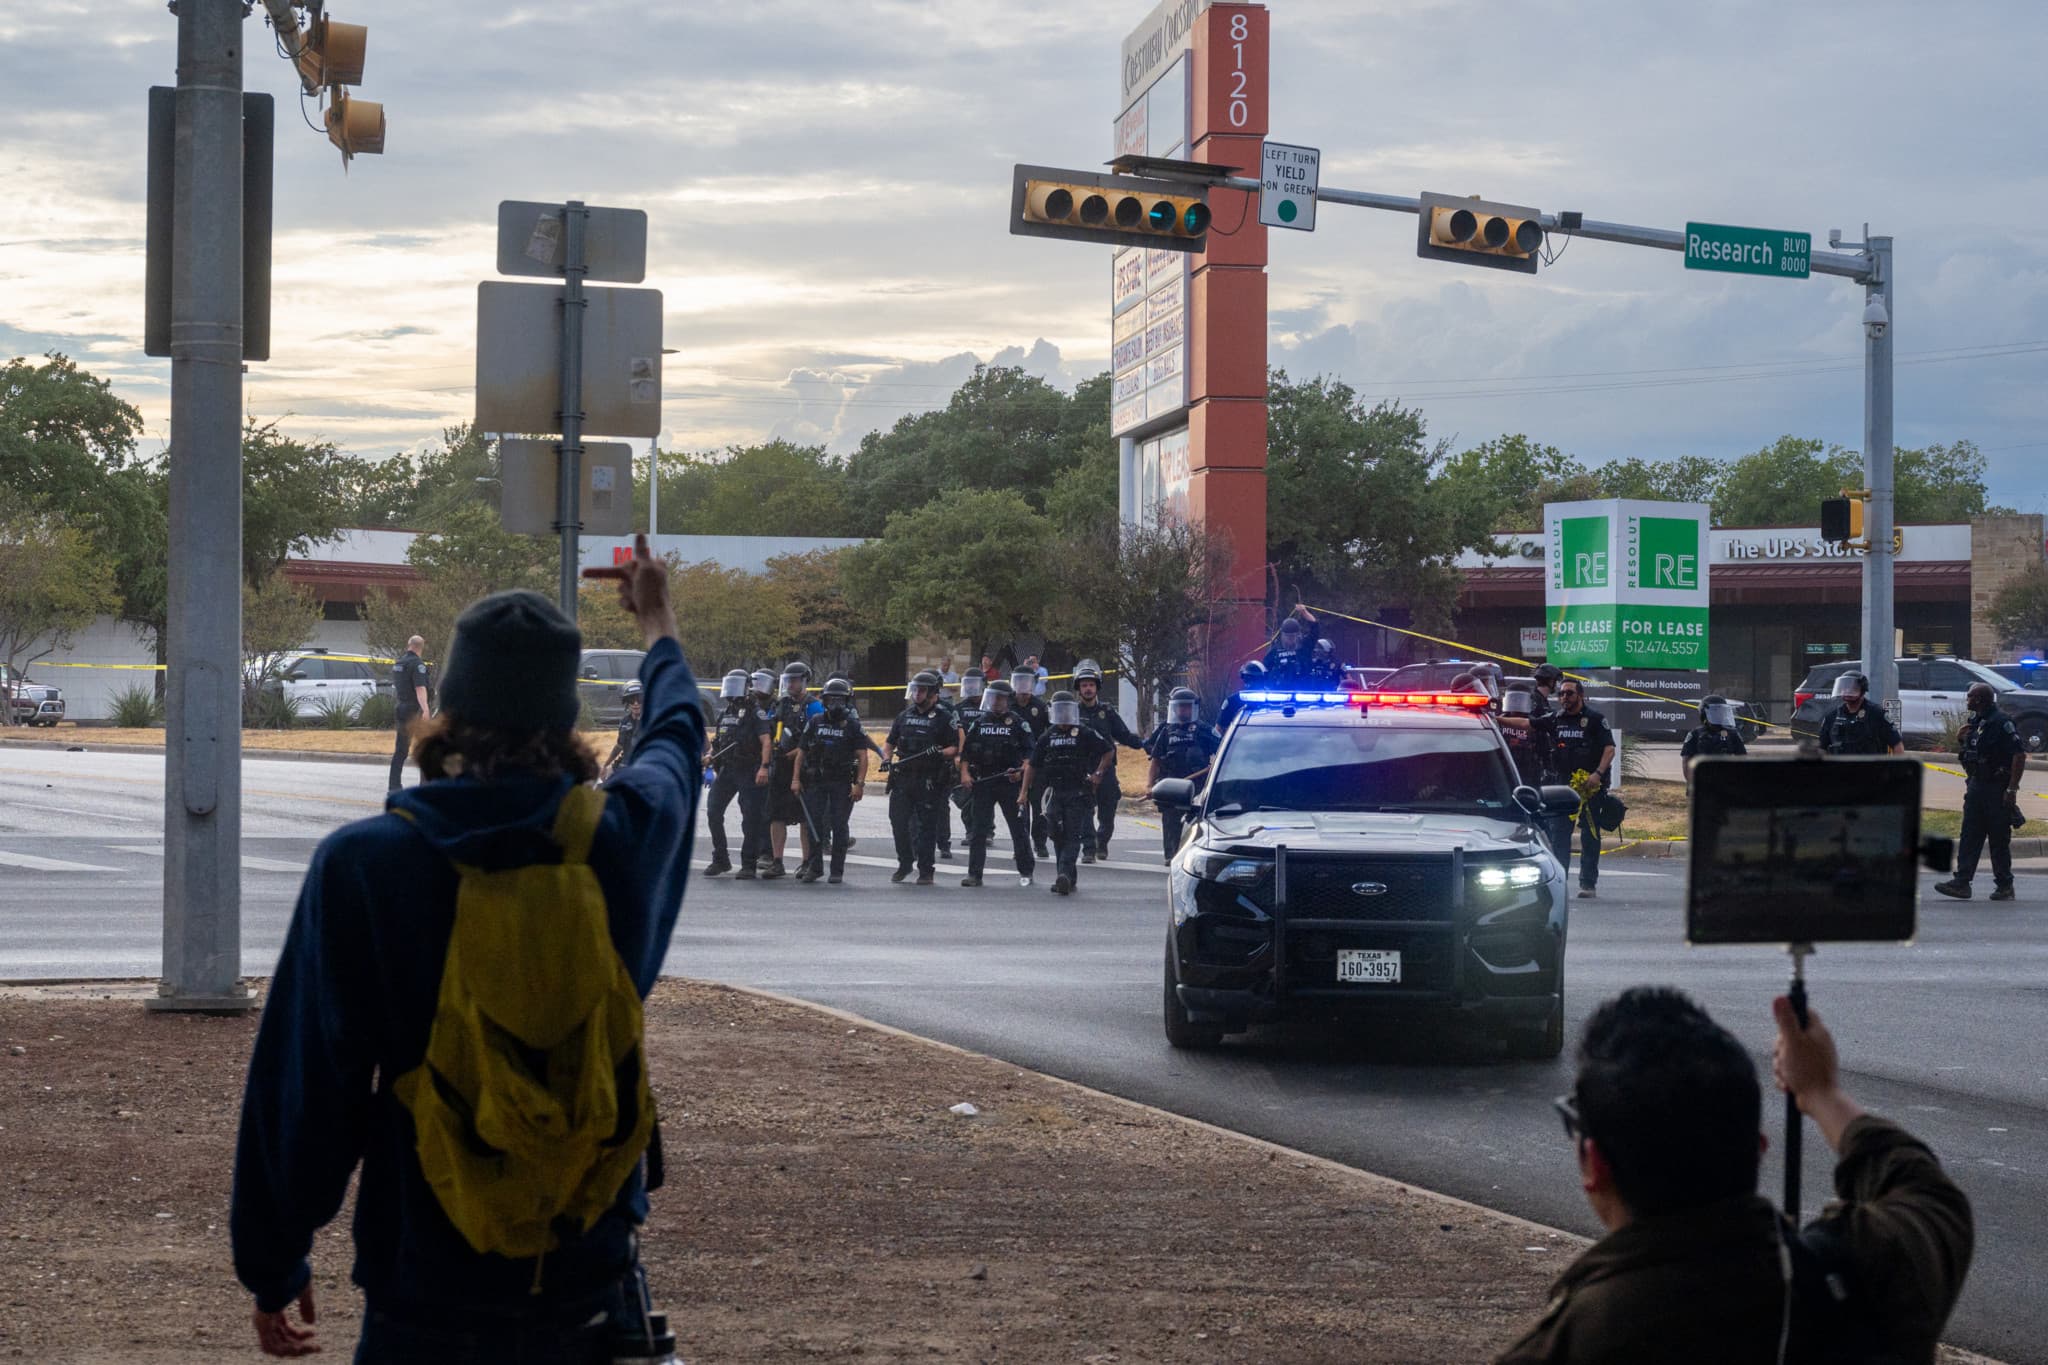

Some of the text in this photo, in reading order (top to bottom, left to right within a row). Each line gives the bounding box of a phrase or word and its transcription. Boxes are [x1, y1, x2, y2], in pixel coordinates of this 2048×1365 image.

[1229, 14, 1248, 127] 8120
[1265, 149, 1316, 165] LEFT TURN
[1275, 164, 1306, 180] YIELD
[1265, 180, 1312, 195] ON GREEN
[1688, 233, 1773, 265] Research
[1783, 237, 1807, 254] BLVD
[1781, 256, 1806, 272] 8000
[1553, 519, 1561, 590] RESOLUT
[1628, 515, 1637, 589] RESOLUT
[1725, 539, 1759, 559] The
[1765, 538, 1807, 559] UPS
[1575, 552, 1606, 585] RE
[1655, 553, 1695, 586] RE
[1551, 620, 1612, 635] FOR LEASE
[1622, 621, 1704, 636] FOR LEASE
[1554, 639, 1609, 654] 512.474.5557
[1625, 640, 1700, 655] 512.474.5557
[1626, 679, 1701, 690] Michael Noteboom
[1640, 711, 1686, 722] Hill Morgan
[817, 728, 844, 737] POLICE
[980, 726, 1012, 736] POLICE
[1558, 730, 1584, 739] POLICE
[1050, 738, 1077, 747] POLICE
